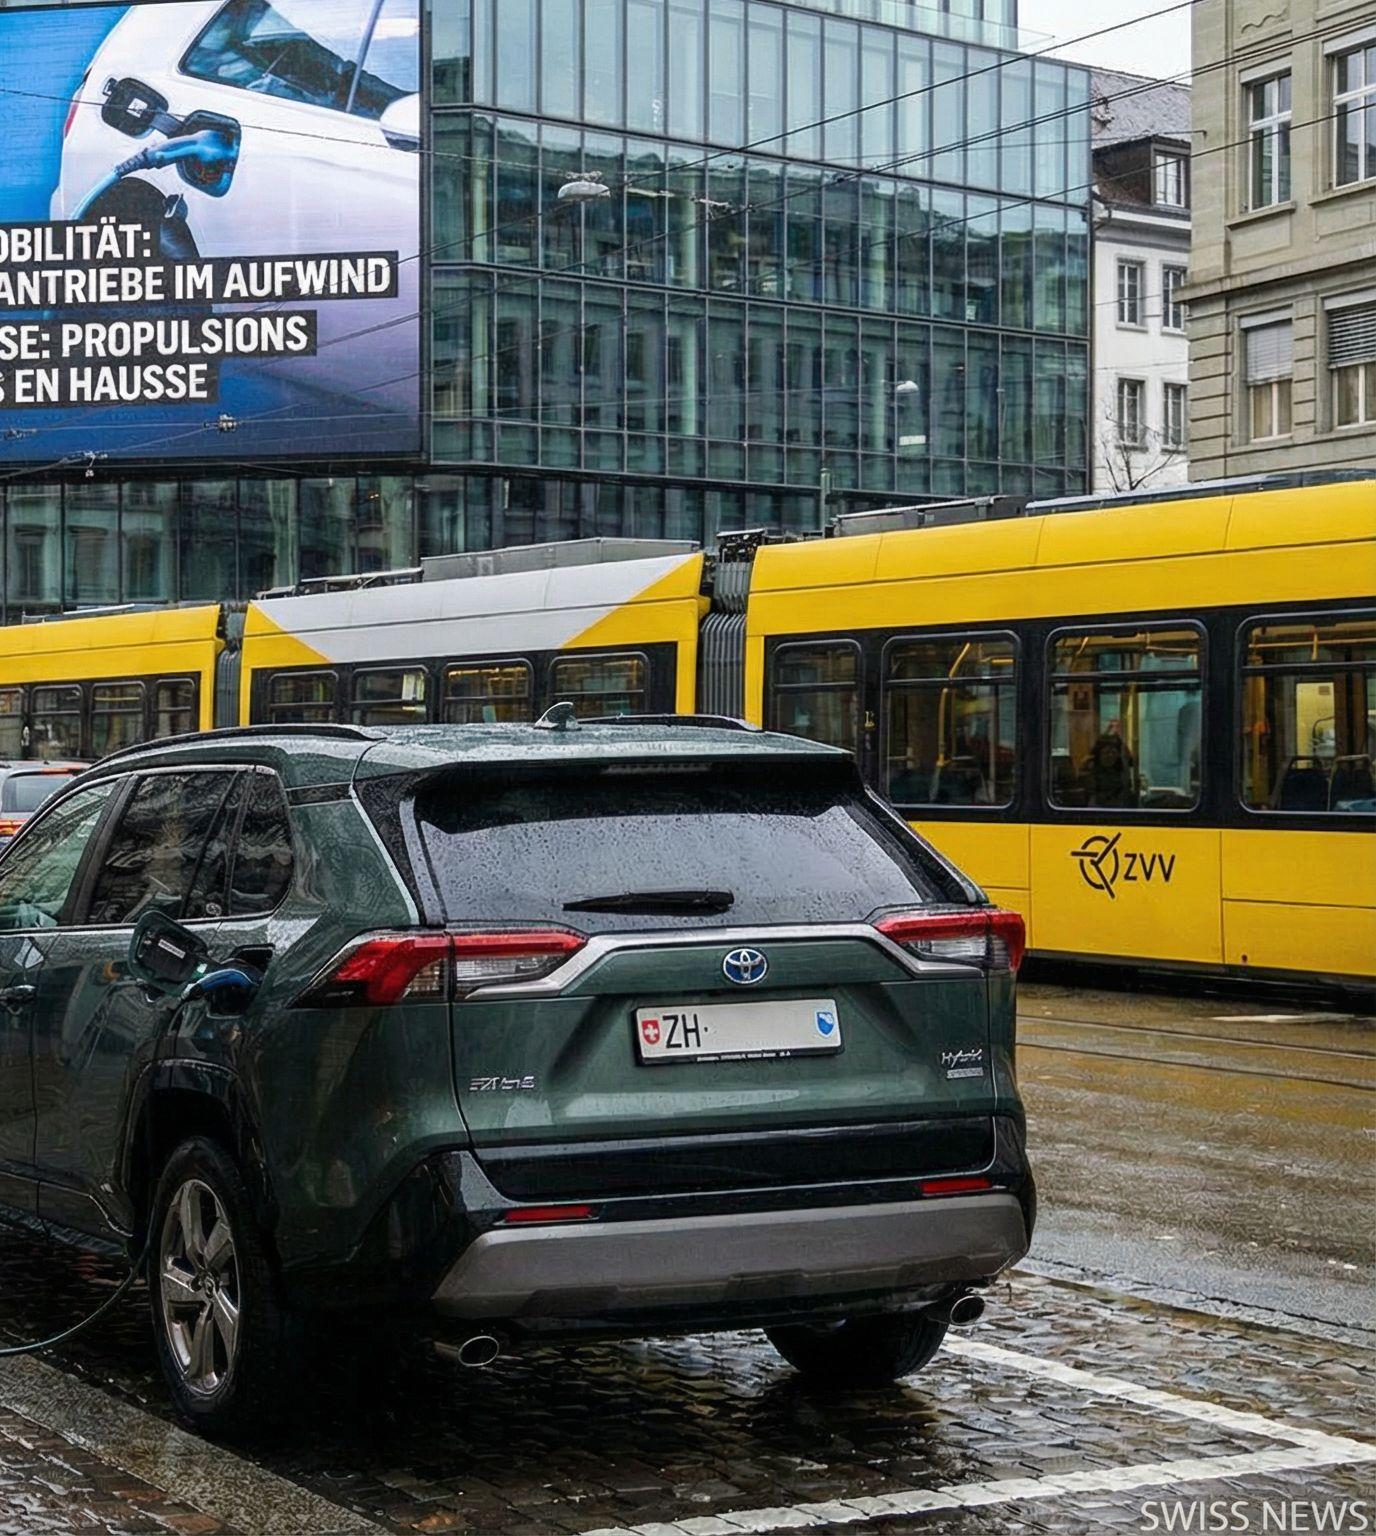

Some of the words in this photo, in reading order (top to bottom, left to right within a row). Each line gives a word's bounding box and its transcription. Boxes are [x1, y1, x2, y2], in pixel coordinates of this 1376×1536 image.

[174, 263, 214, 300] IM
[223, 257, 391, 299] AUFWIND
[61, 315, 308, 358] PROPULSIONS
[15, 367, 58, 403] EN
[69, 363, 208, 402] HAUSSE
[1123, 853, 1176, 882] ZVV
